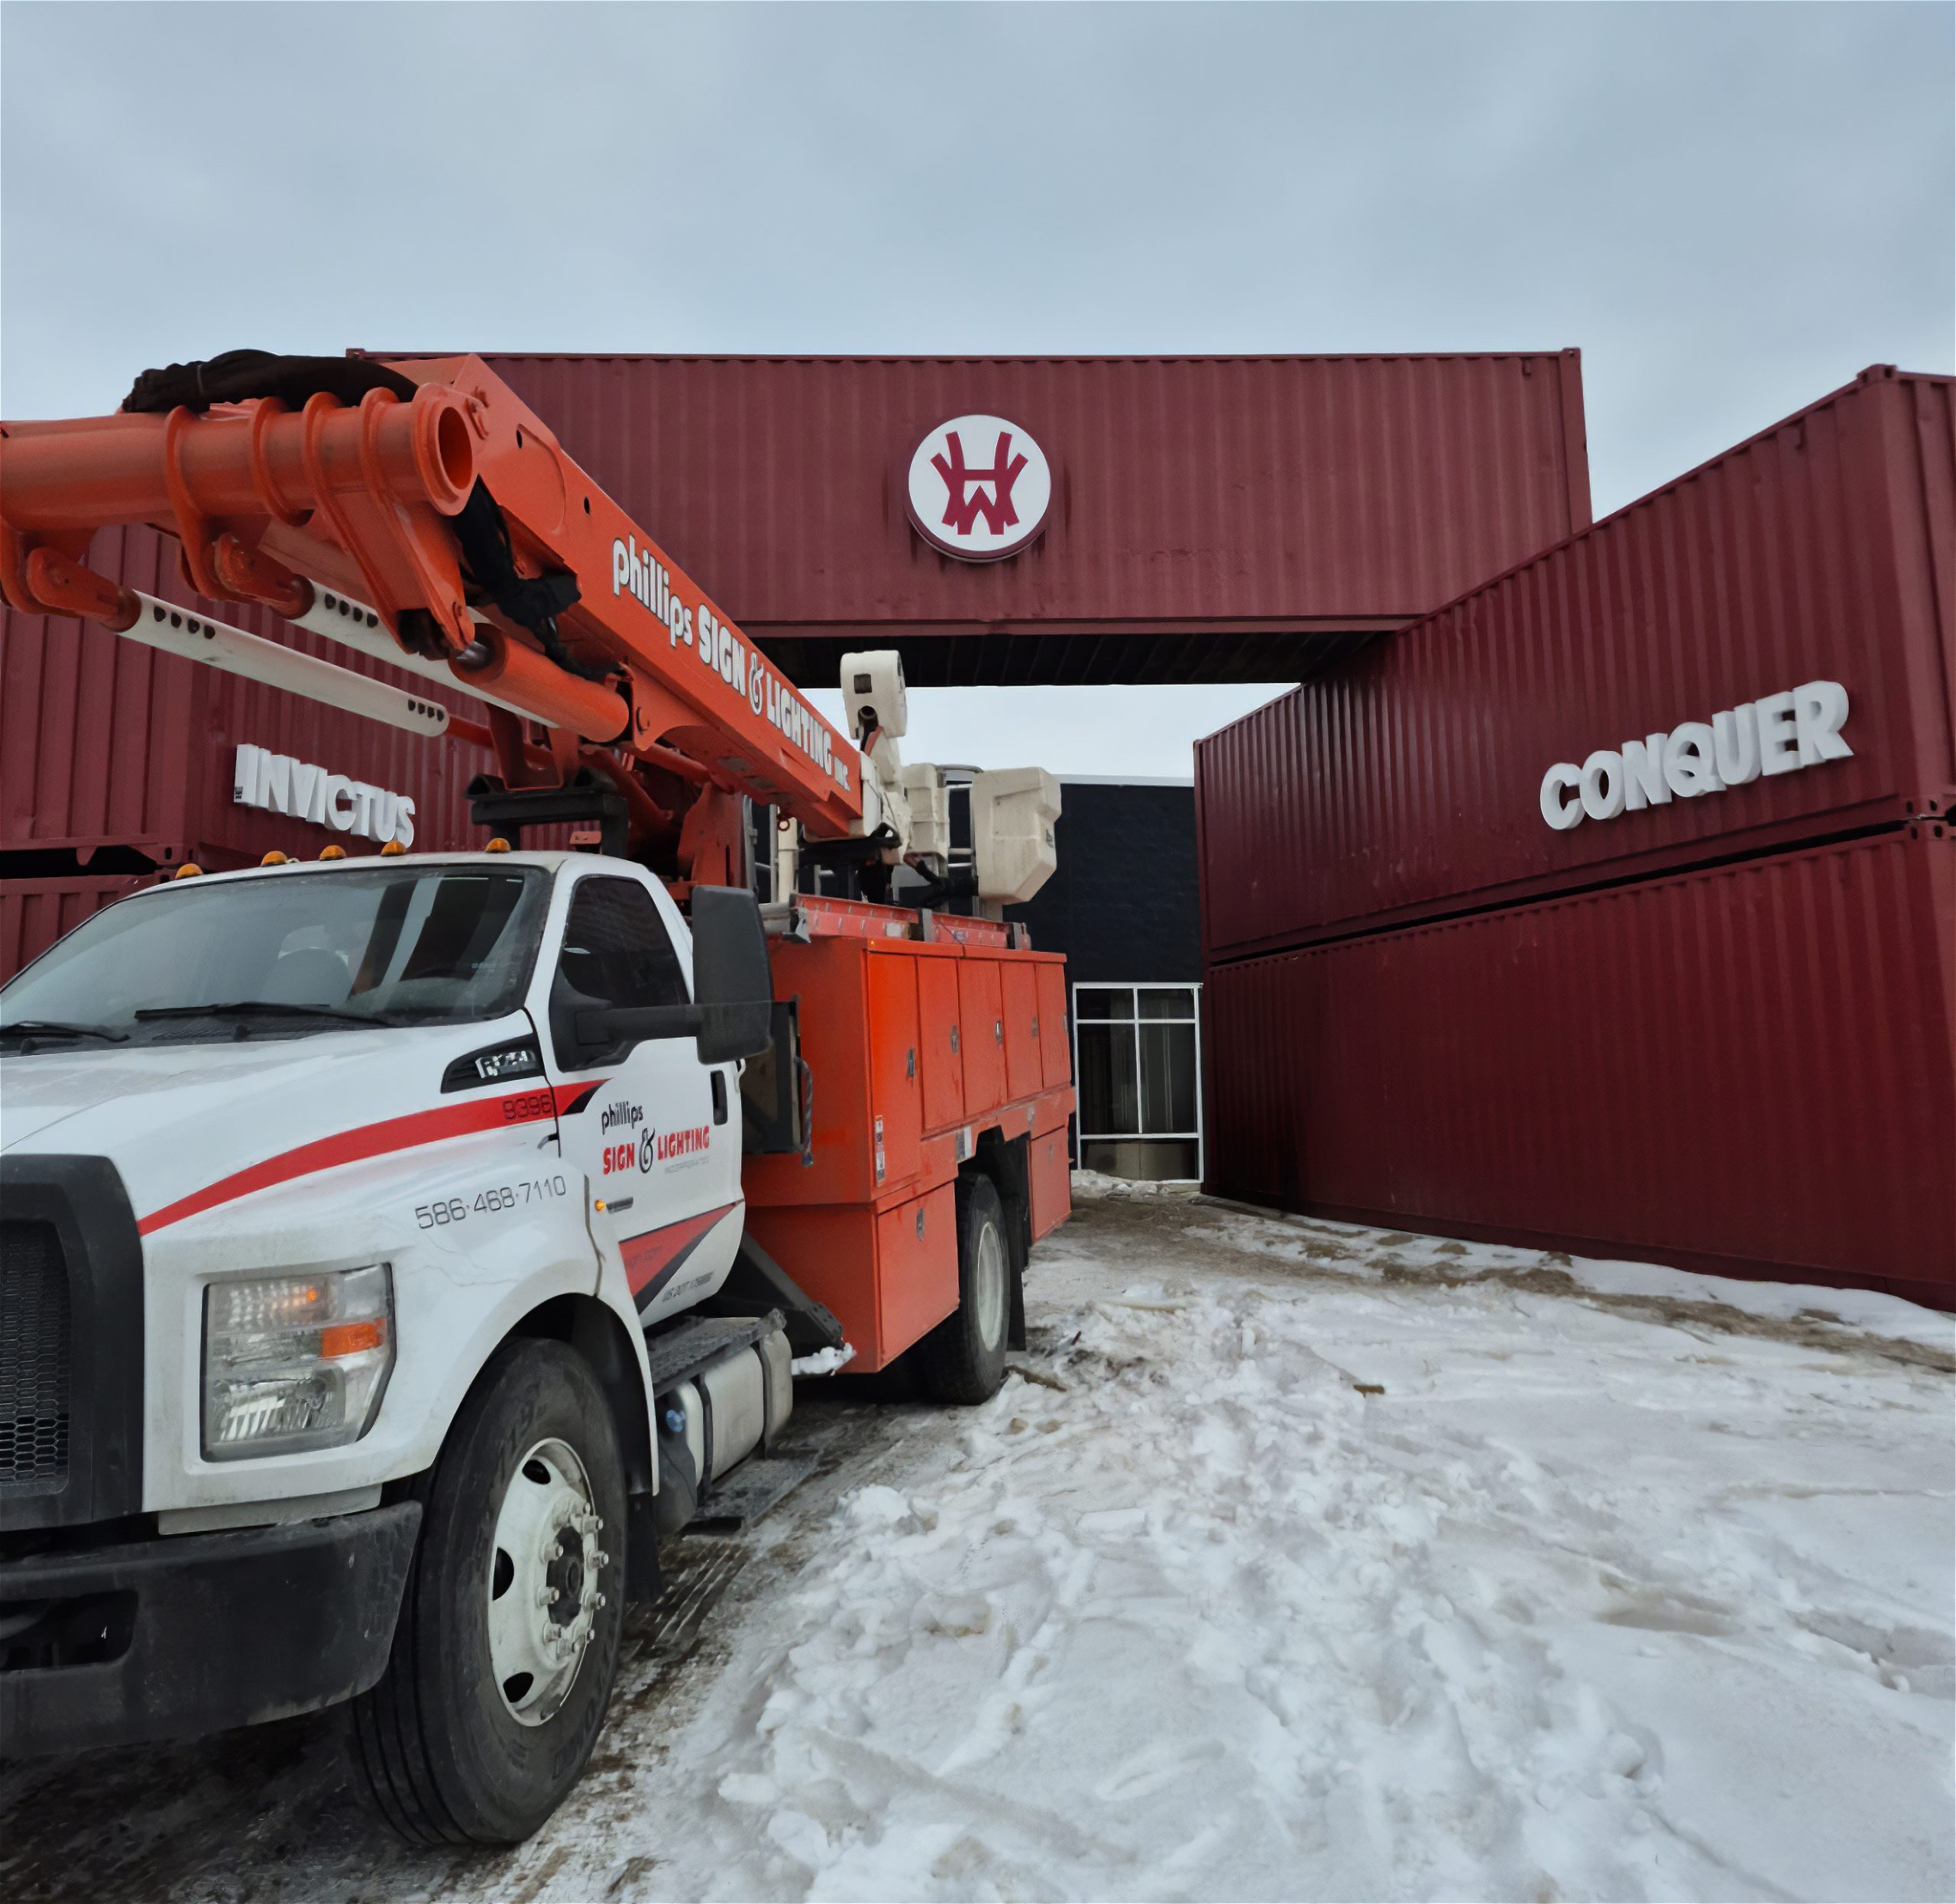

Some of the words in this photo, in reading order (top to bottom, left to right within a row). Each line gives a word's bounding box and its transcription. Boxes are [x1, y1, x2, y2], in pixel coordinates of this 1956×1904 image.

[613, 532, 693, 647] phillips
[698, 603, 746, 697] SIGN
[749, 652, 764, 716] &
[766, 672, 833, 776] LIGHTING
[234, 743, 416, 848] INVICTUS
[1540, 680, 1854, 830] CONQUER
[601, 1100, 644, 1135] phillips
[603, 1142, 636, 1175] SIGN
[639, 1127, 656, 1174] &
[657, 1125, 710, 1161] LIGHTING
